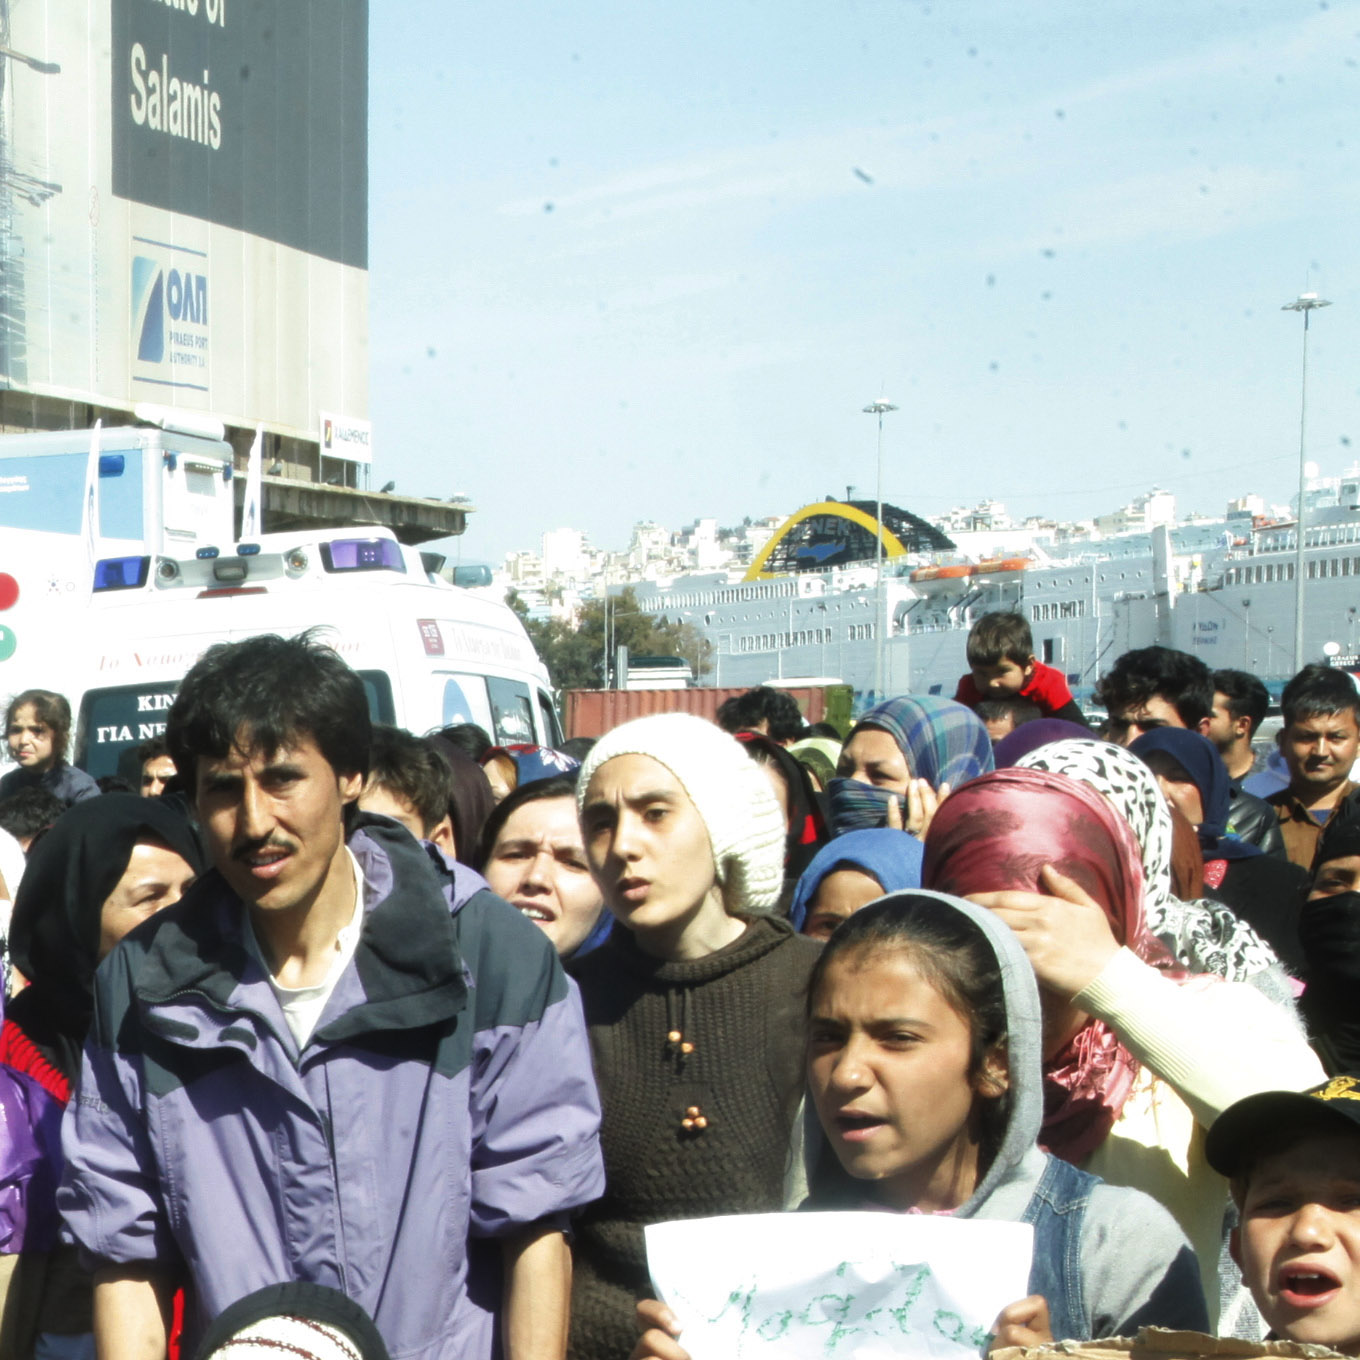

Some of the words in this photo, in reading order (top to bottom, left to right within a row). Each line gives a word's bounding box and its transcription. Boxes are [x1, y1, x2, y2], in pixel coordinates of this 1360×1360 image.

[130, 42, 222, 151] Salamis
[137, 693, 178, 712] ΚΙΝ
[97, 725, 133, 744] ΓΙΑ
